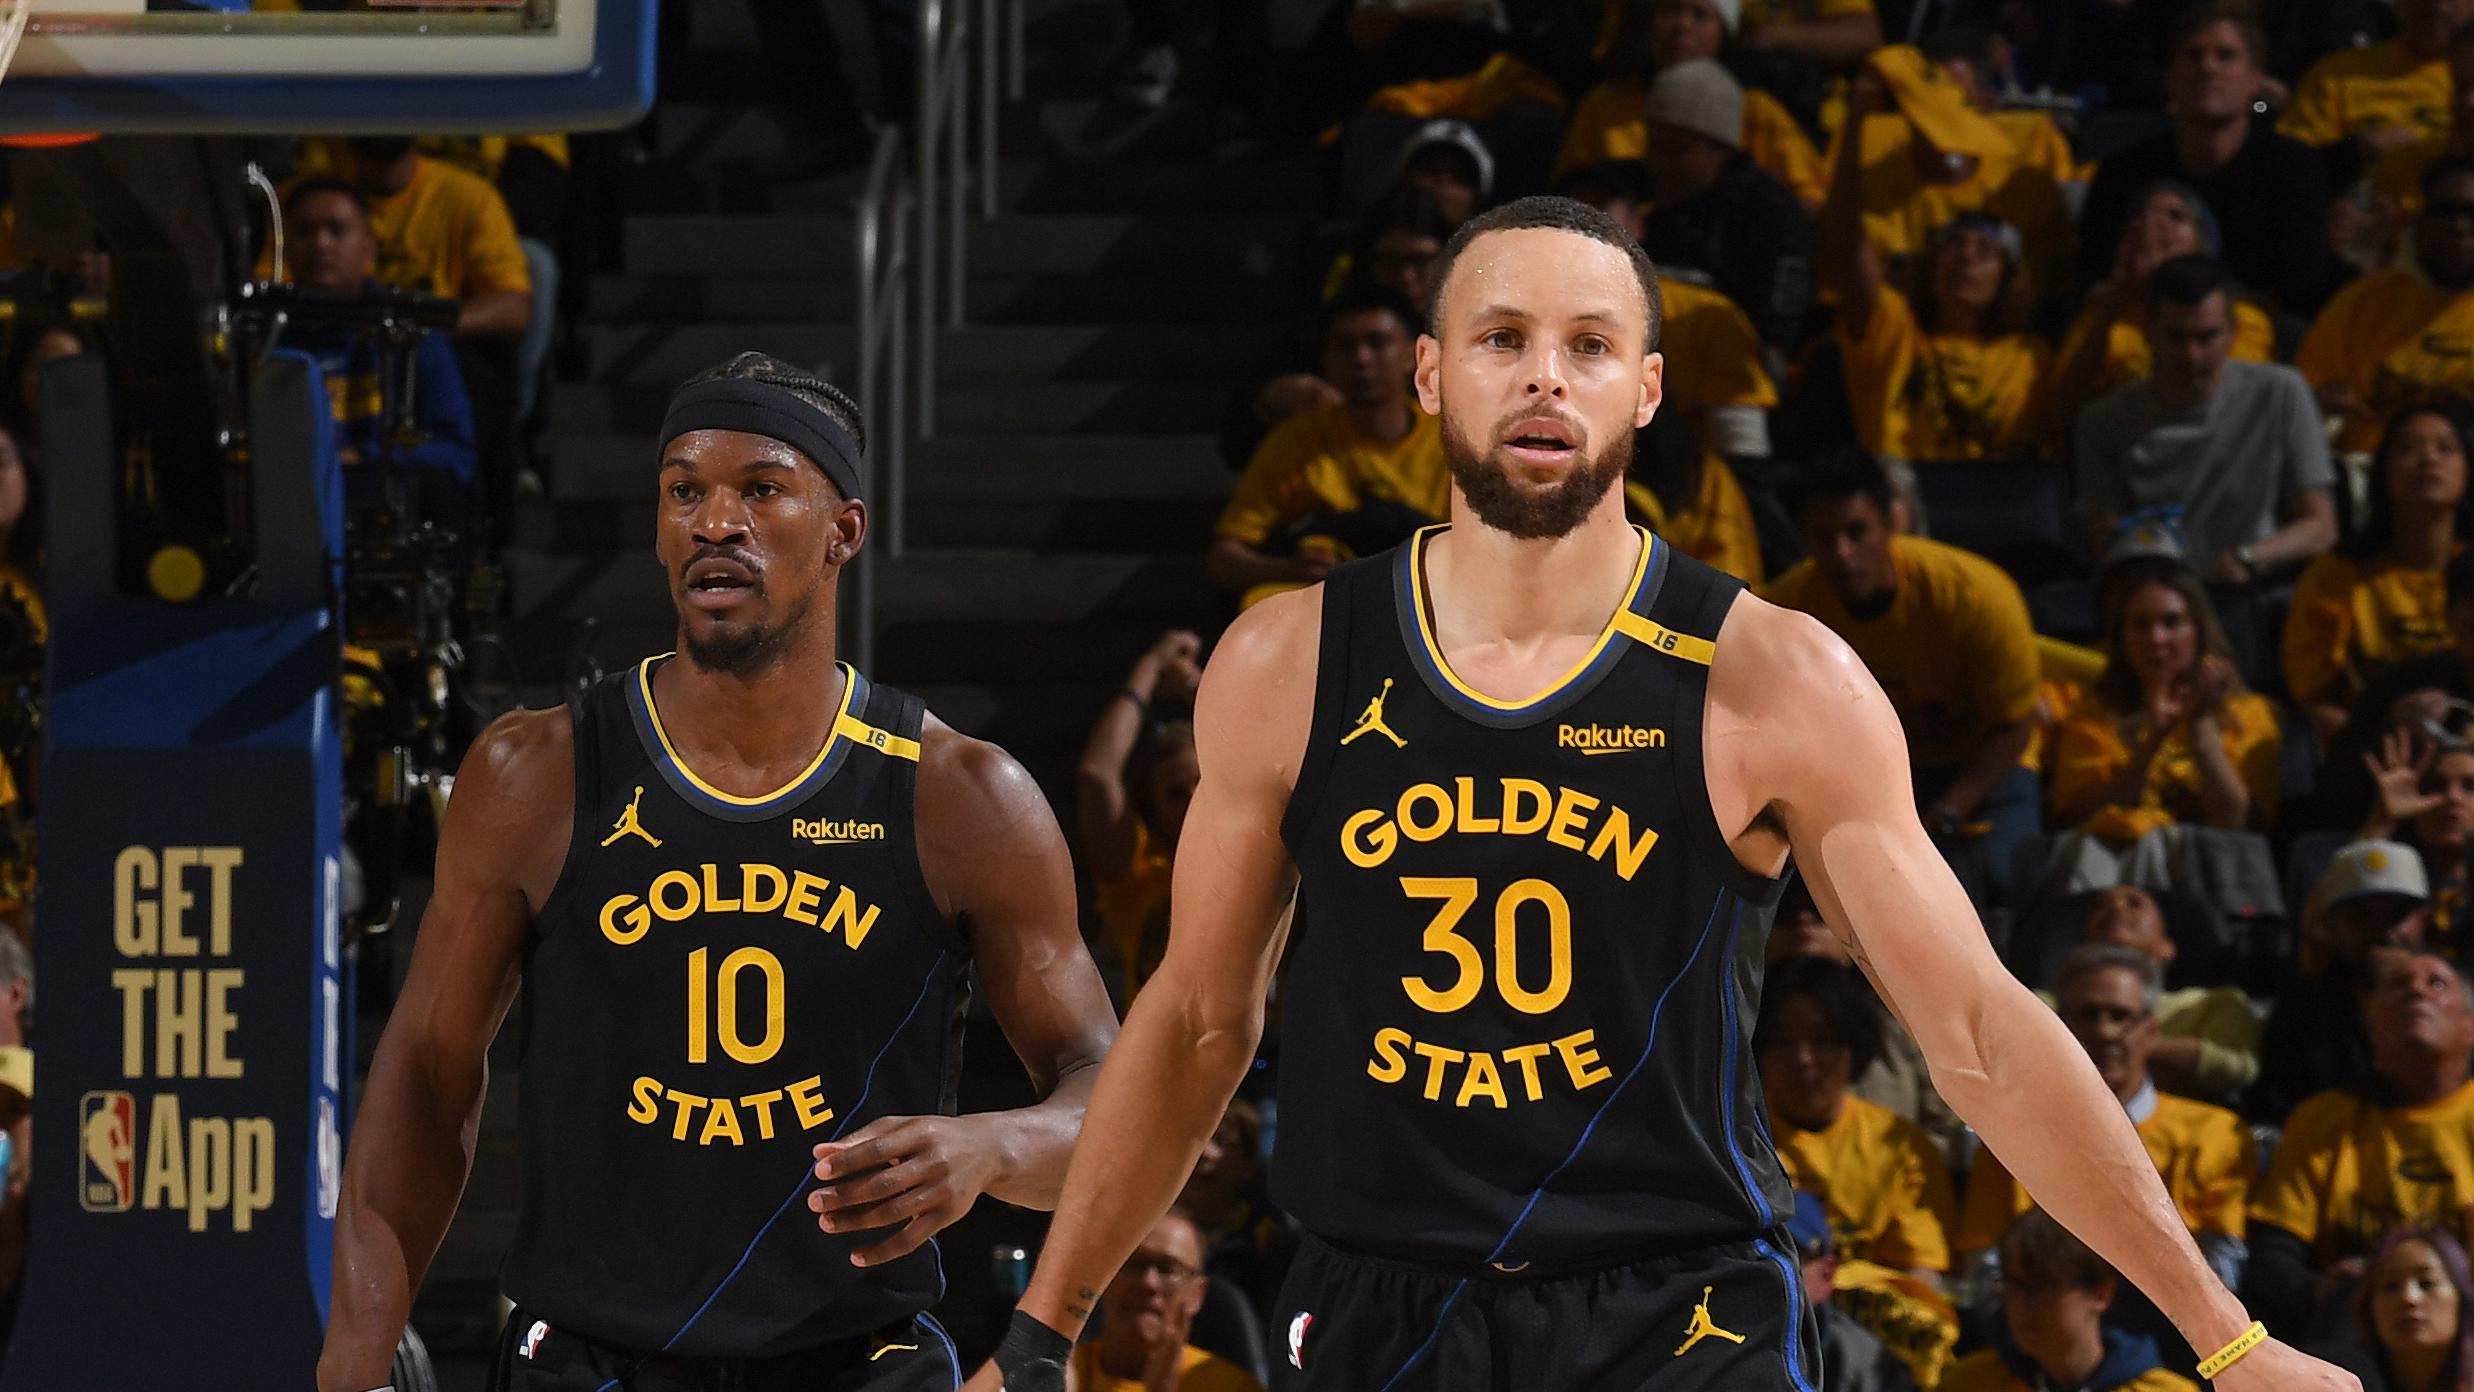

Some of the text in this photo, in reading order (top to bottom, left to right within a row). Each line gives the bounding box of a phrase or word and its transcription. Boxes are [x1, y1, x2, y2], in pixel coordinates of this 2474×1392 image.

[1653, 630, 1678, 650] 16
[866, 730, 887, 747] 16
[1558, 723, 1665, 748] Rakuten
[792, 817, 885, 840] Rakuten
[1340, 777, 1659, 881] GOLDEN
[113, 845, 244, 957] GET
[599, 863, 882, 950] GOLDEN
[1400, 876, 1572, 1014] 30
[111, 969, 245, 1079] THE
[687, 946, 785, 1064] 10
[627, 1075, 834, 1146] STATE
[1366, 1027, 1612, 1108] STATE
[142, 1093, 275, 1232] App
